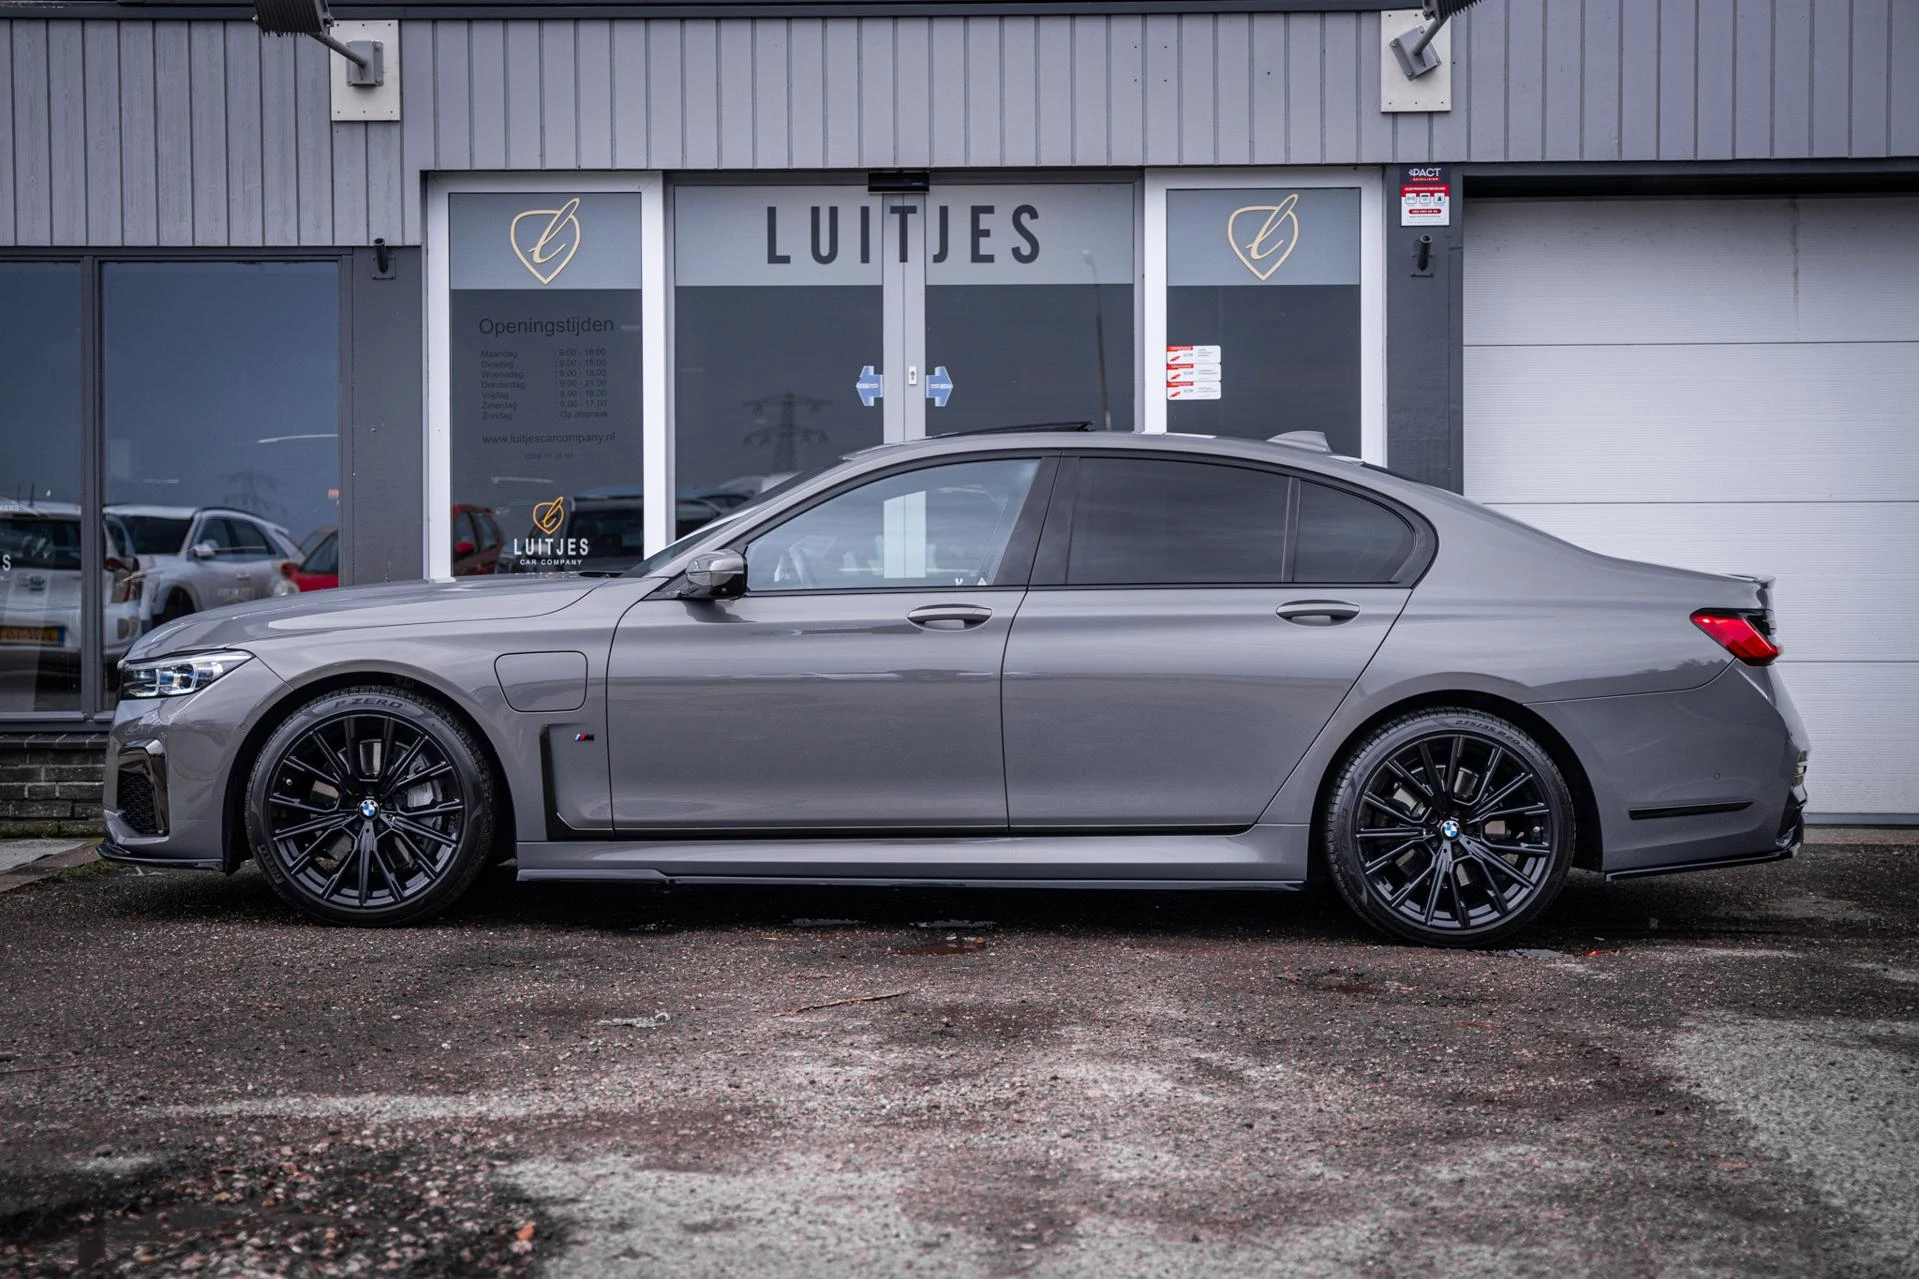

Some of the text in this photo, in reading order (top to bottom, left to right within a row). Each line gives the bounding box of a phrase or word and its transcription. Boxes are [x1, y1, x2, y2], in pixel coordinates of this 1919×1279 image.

[767, 204, 1040, 265] LUITJES
[479, 317, 614, 337] Openingstijden
[482, 432, 616, 445] www.luitjescarcompany.nl
[513, 538, 589, 556] LUITJES
